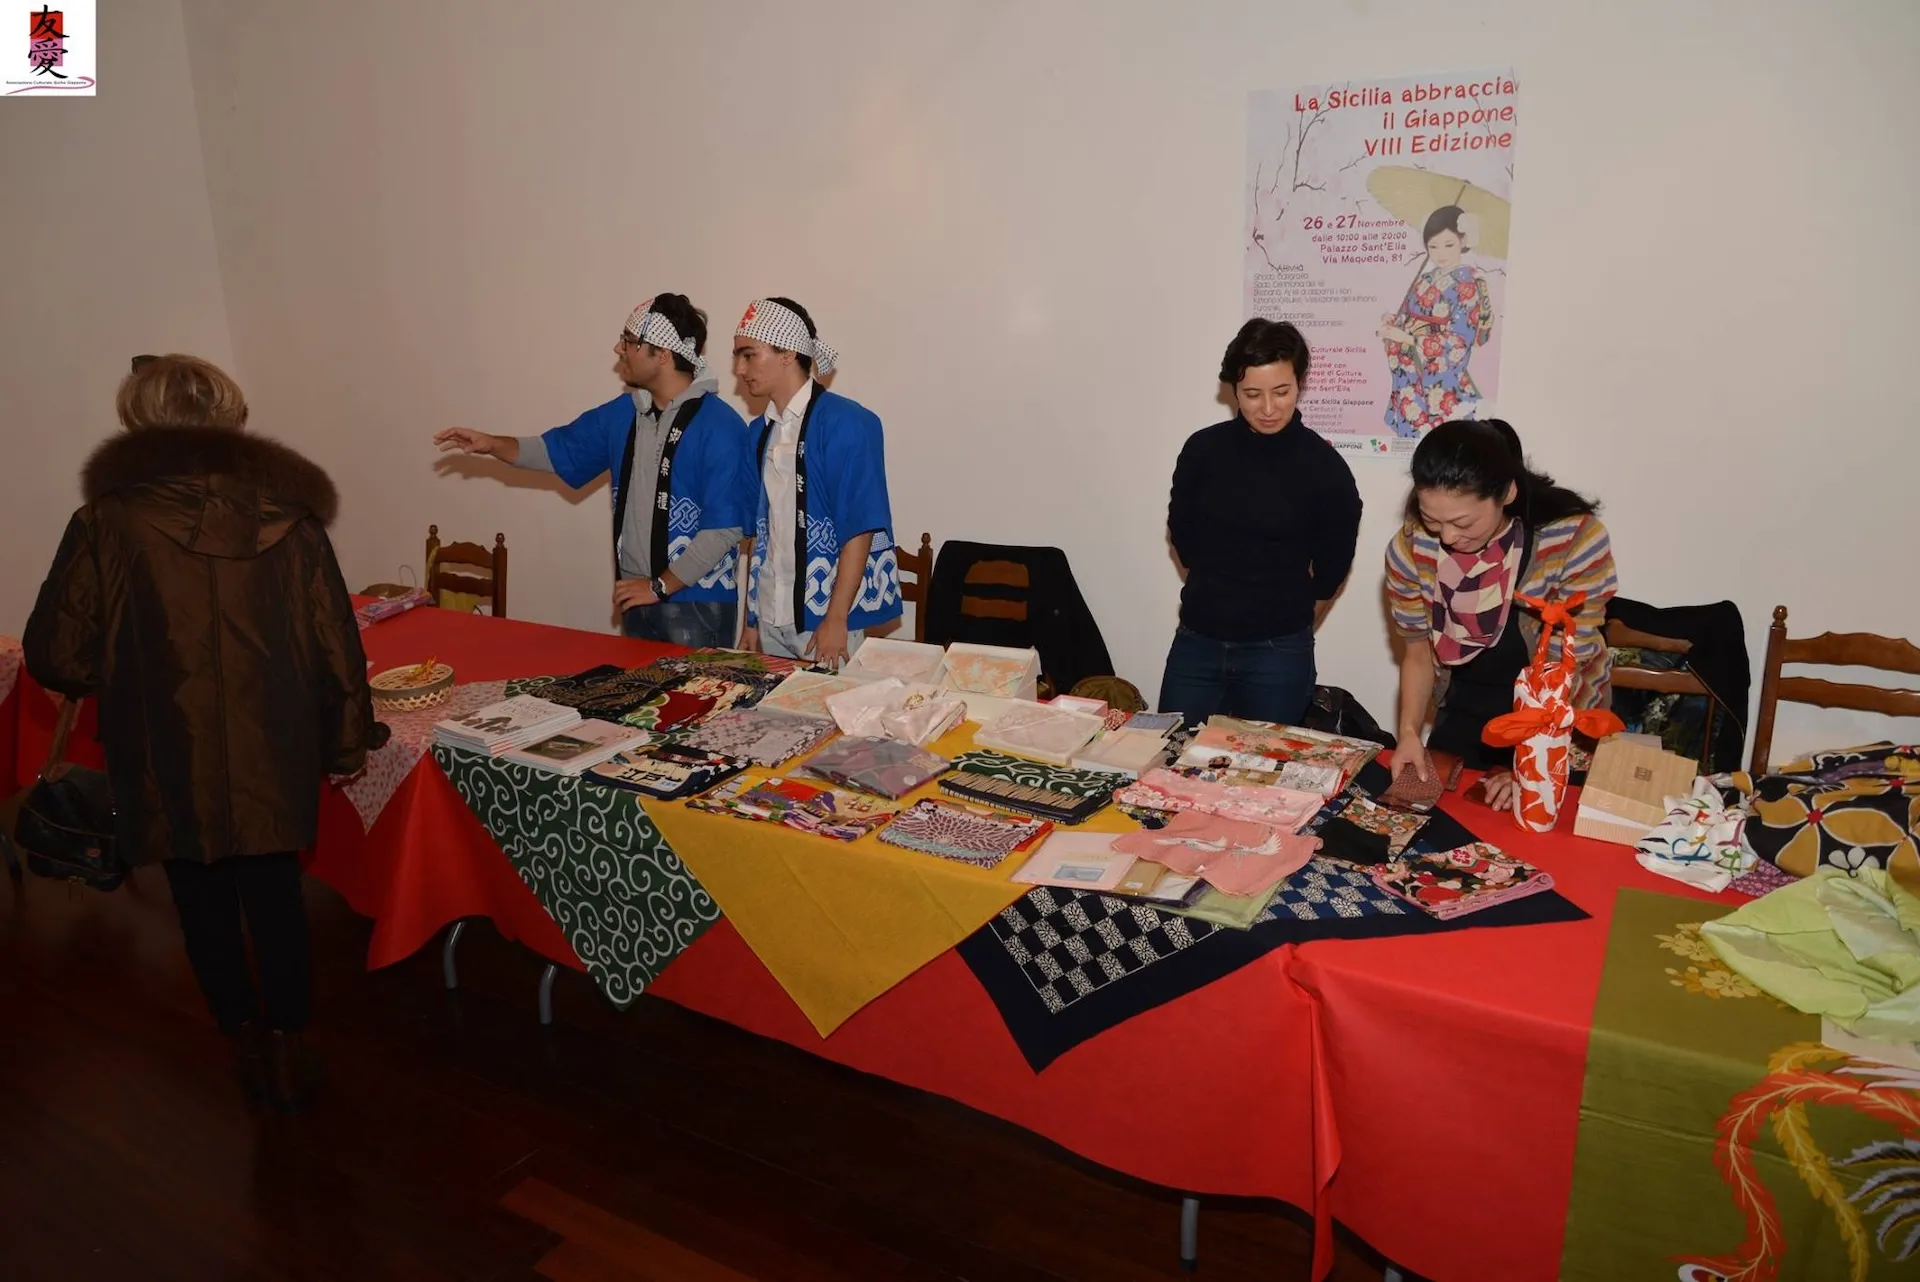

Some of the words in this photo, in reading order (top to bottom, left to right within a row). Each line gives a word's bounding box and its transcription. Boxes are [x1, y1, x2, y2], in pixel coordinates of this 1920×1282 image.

[1294, 93, 1320, 112] La
[1327, 87, 1392, 109] Sicilia
[1402, 76, 1514, 103] abbraccia
[1383, 112, 1395, 130] il
[1404, 105, 1514, 129] Giappone
[1364, 136, 1402, 157] VIII
[1411, 132, 1513, 154] Edizione
[1303, 216, 1323, 230] 26
[1335, 214, 1357, 229] 27
[1357, 219, 1405, 228] Novembre
[1336, 233, 1359, 241] 10:00
[1381, 231, 1407, 240] 20:00
[1320, 244, 1358, 253] Palazzo
[1361, 242, 1406, 252] Sant'Elia
[1322, 255, 1337, 264] Via
[1341, 254, 1388, 264] Maqueda,
[1391, 253, 1403, 262] 81
